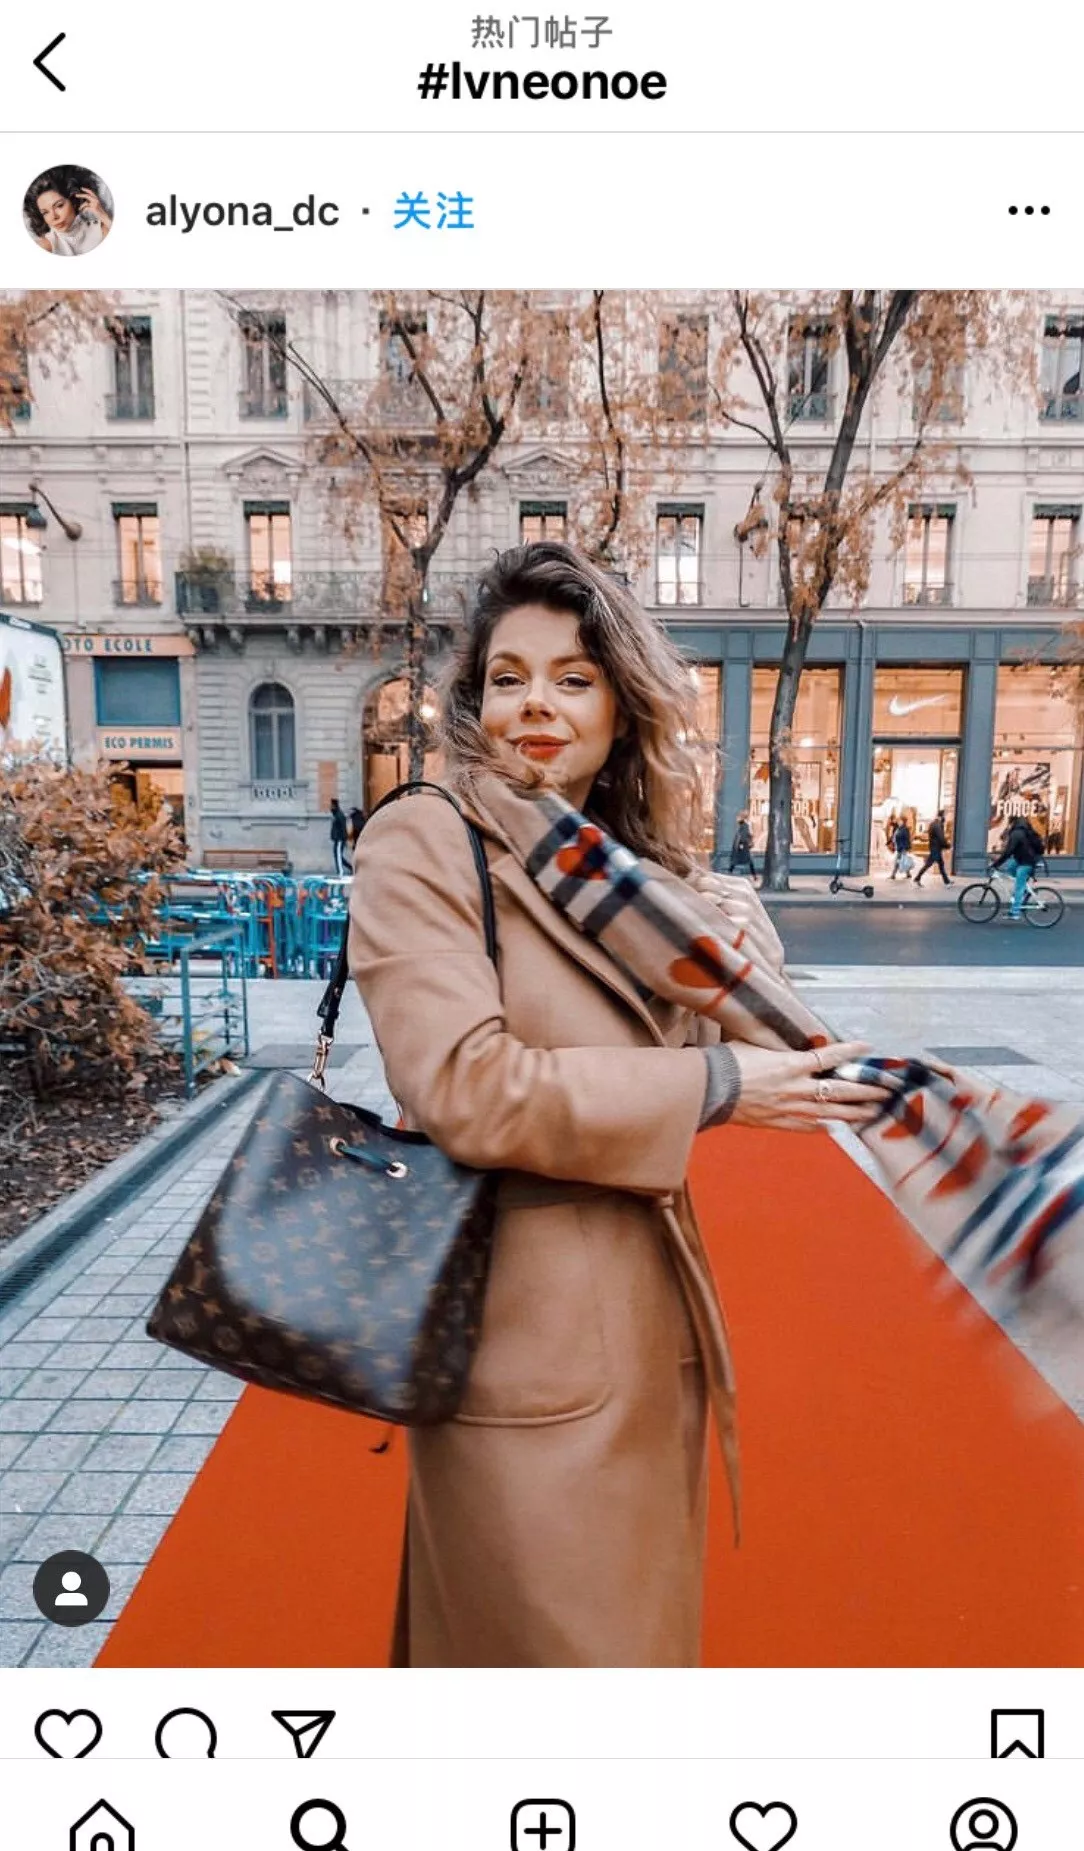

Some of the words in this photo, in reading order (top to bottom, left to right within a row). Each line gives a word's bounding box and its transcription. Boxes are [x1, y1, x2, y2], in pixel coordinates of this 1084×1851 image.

[104, 639, 153, 653] ECOLE
[104, 736, 126, 749] ECO
[129, 736, 174, 749] PERMIS
[996, 799, 1038, 818] FORCE
